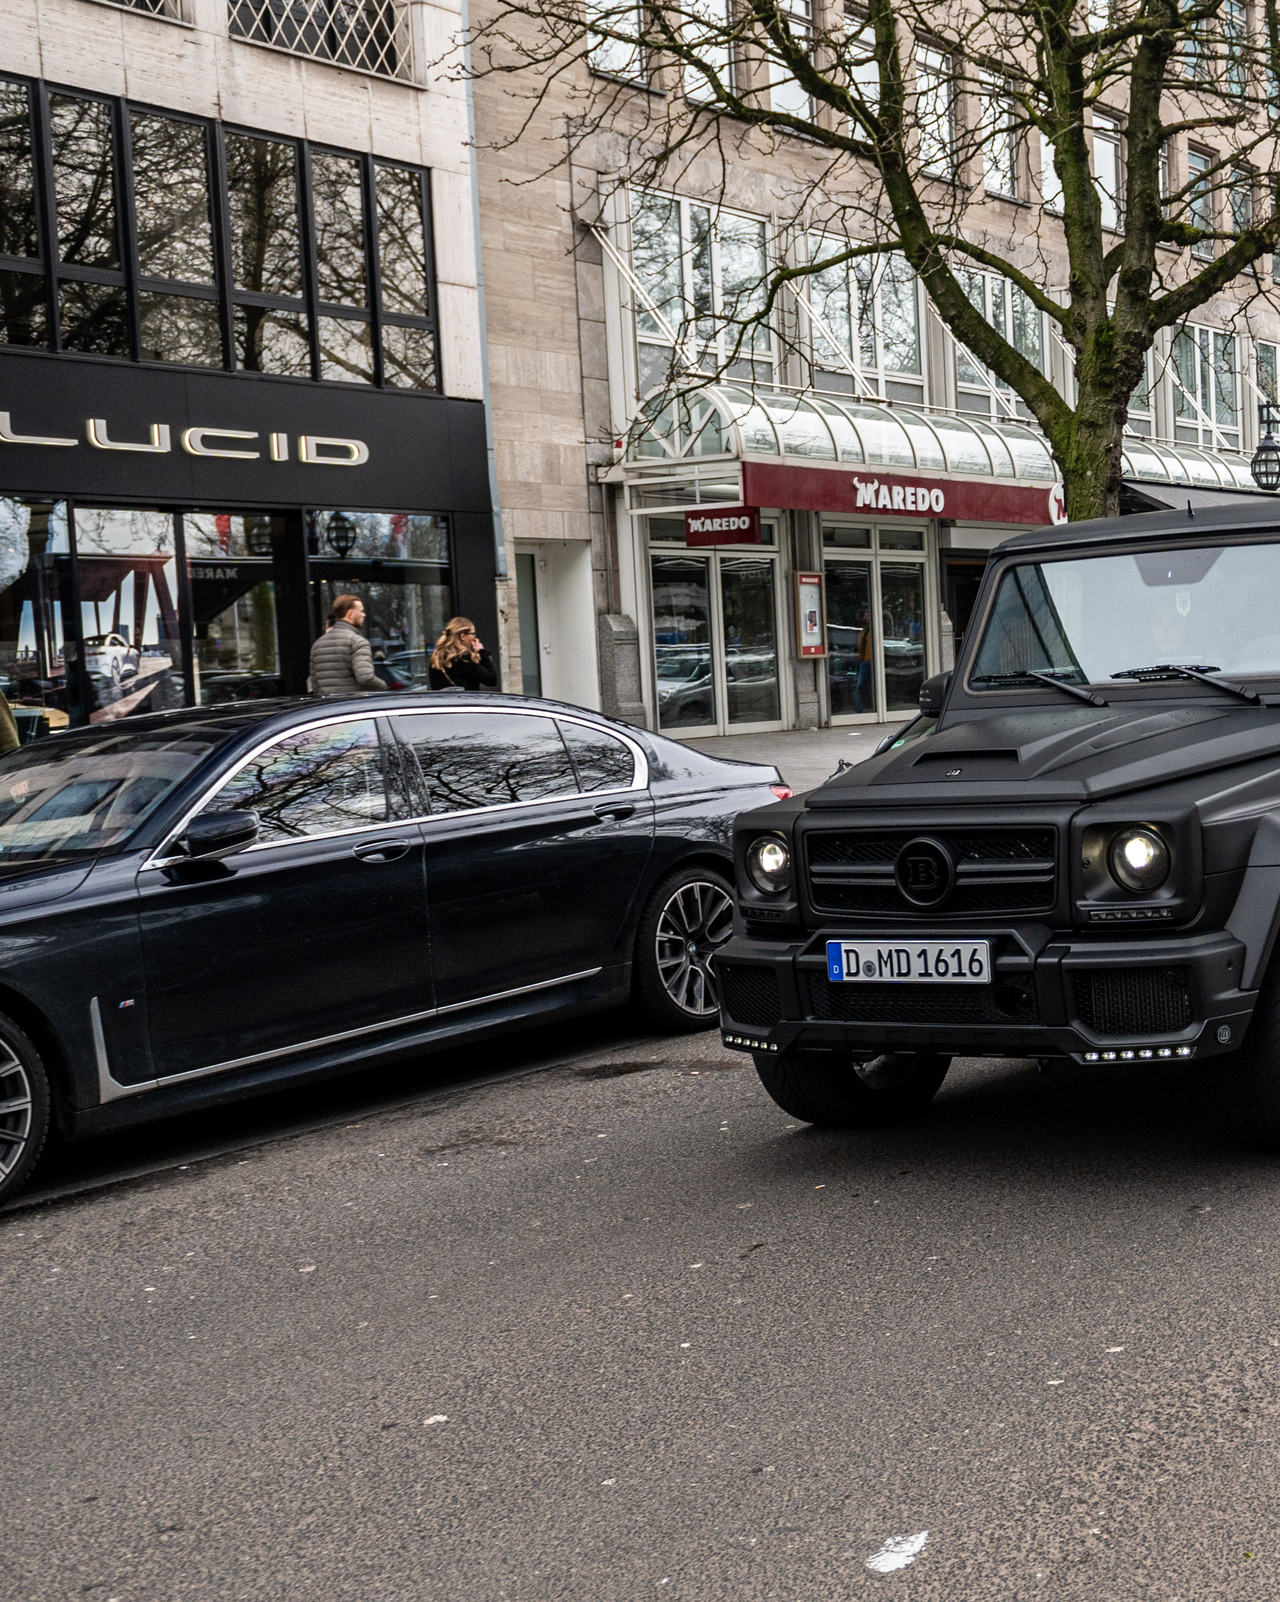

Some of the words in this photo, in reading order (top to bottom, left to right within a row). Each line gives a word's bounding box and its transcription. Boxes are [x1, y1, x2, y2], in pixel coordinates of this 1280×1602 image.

[0, 411, 369, 465] LUCID
[852, 477, 945, 513] MAREDO
[688, 516, 750, 533] MAREDO
[844, 948, 860, 977] D
[877, 948, 911, 977] MD
[917, 947, 984, 978] 1616
